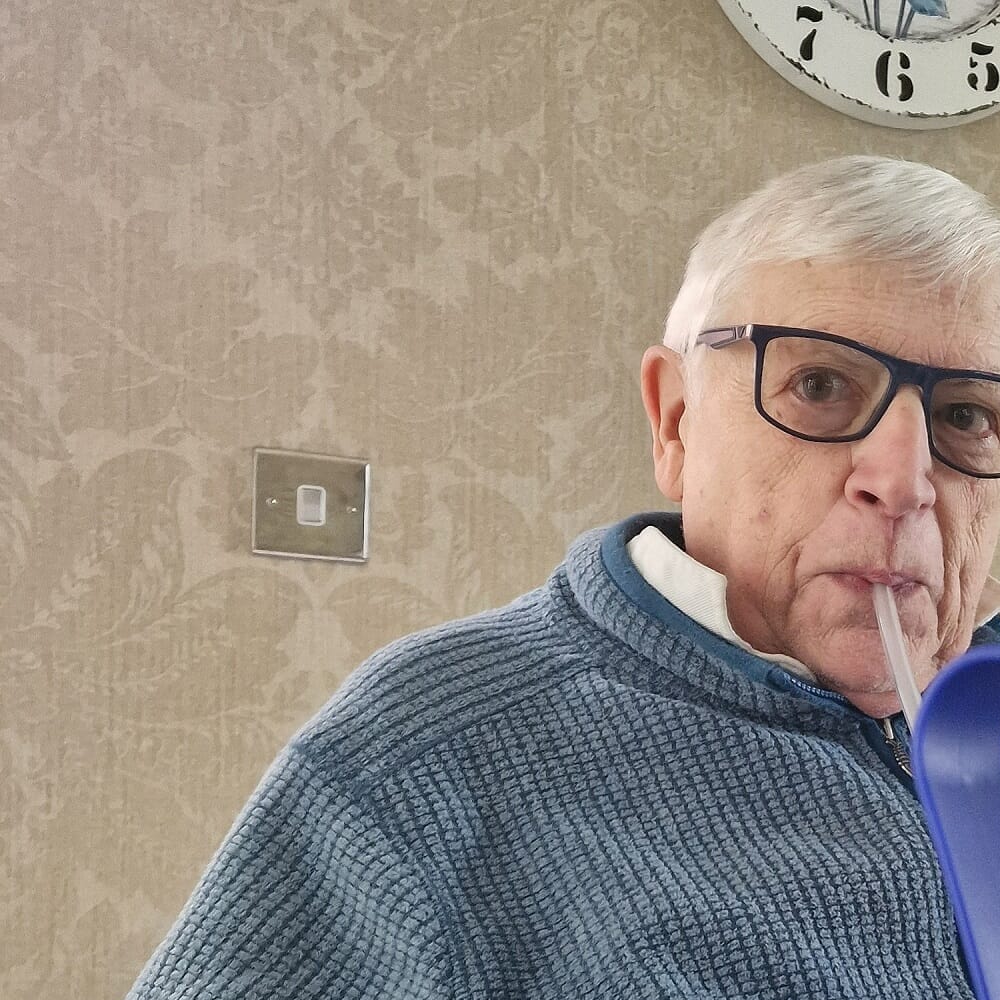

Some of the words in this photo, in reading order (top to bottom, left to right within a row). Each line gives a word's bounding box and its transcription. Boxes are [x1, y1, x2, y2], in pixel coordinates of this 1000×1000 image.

[796, 6, 823, 61] 7
[875, 50, 914, 101] 6
[966, 42, 1000, 92] 5
